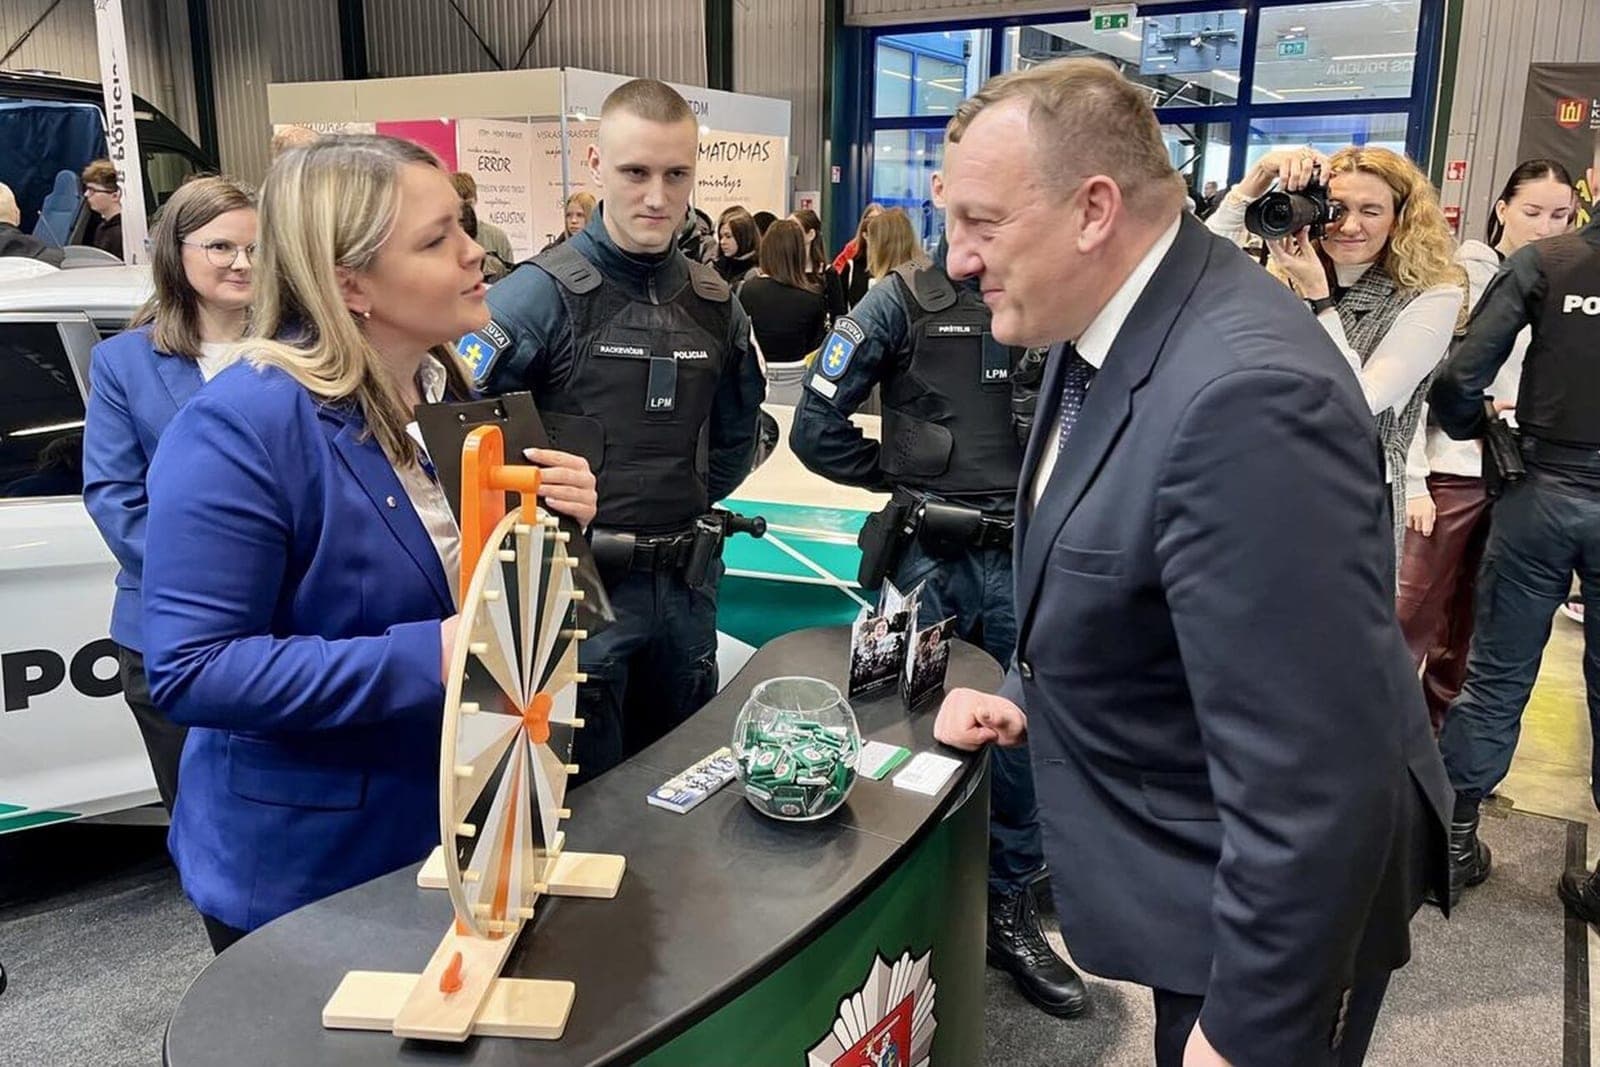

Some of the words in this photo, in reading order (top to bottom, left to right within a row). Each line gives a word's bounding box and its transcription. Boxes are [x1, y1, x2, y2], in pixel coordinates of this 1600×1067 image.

[697, 140, 770, 163] MATOMAS
[478, 155, 511, 173] ERROR
[1562, 294, 1600, 316] PO
[672, 350, 709, 360] POLICIJA
[985, 369, 1008, 379] LPM
[650, 397, 672, 408] LPM
[1, 638, 125, 713] PO
